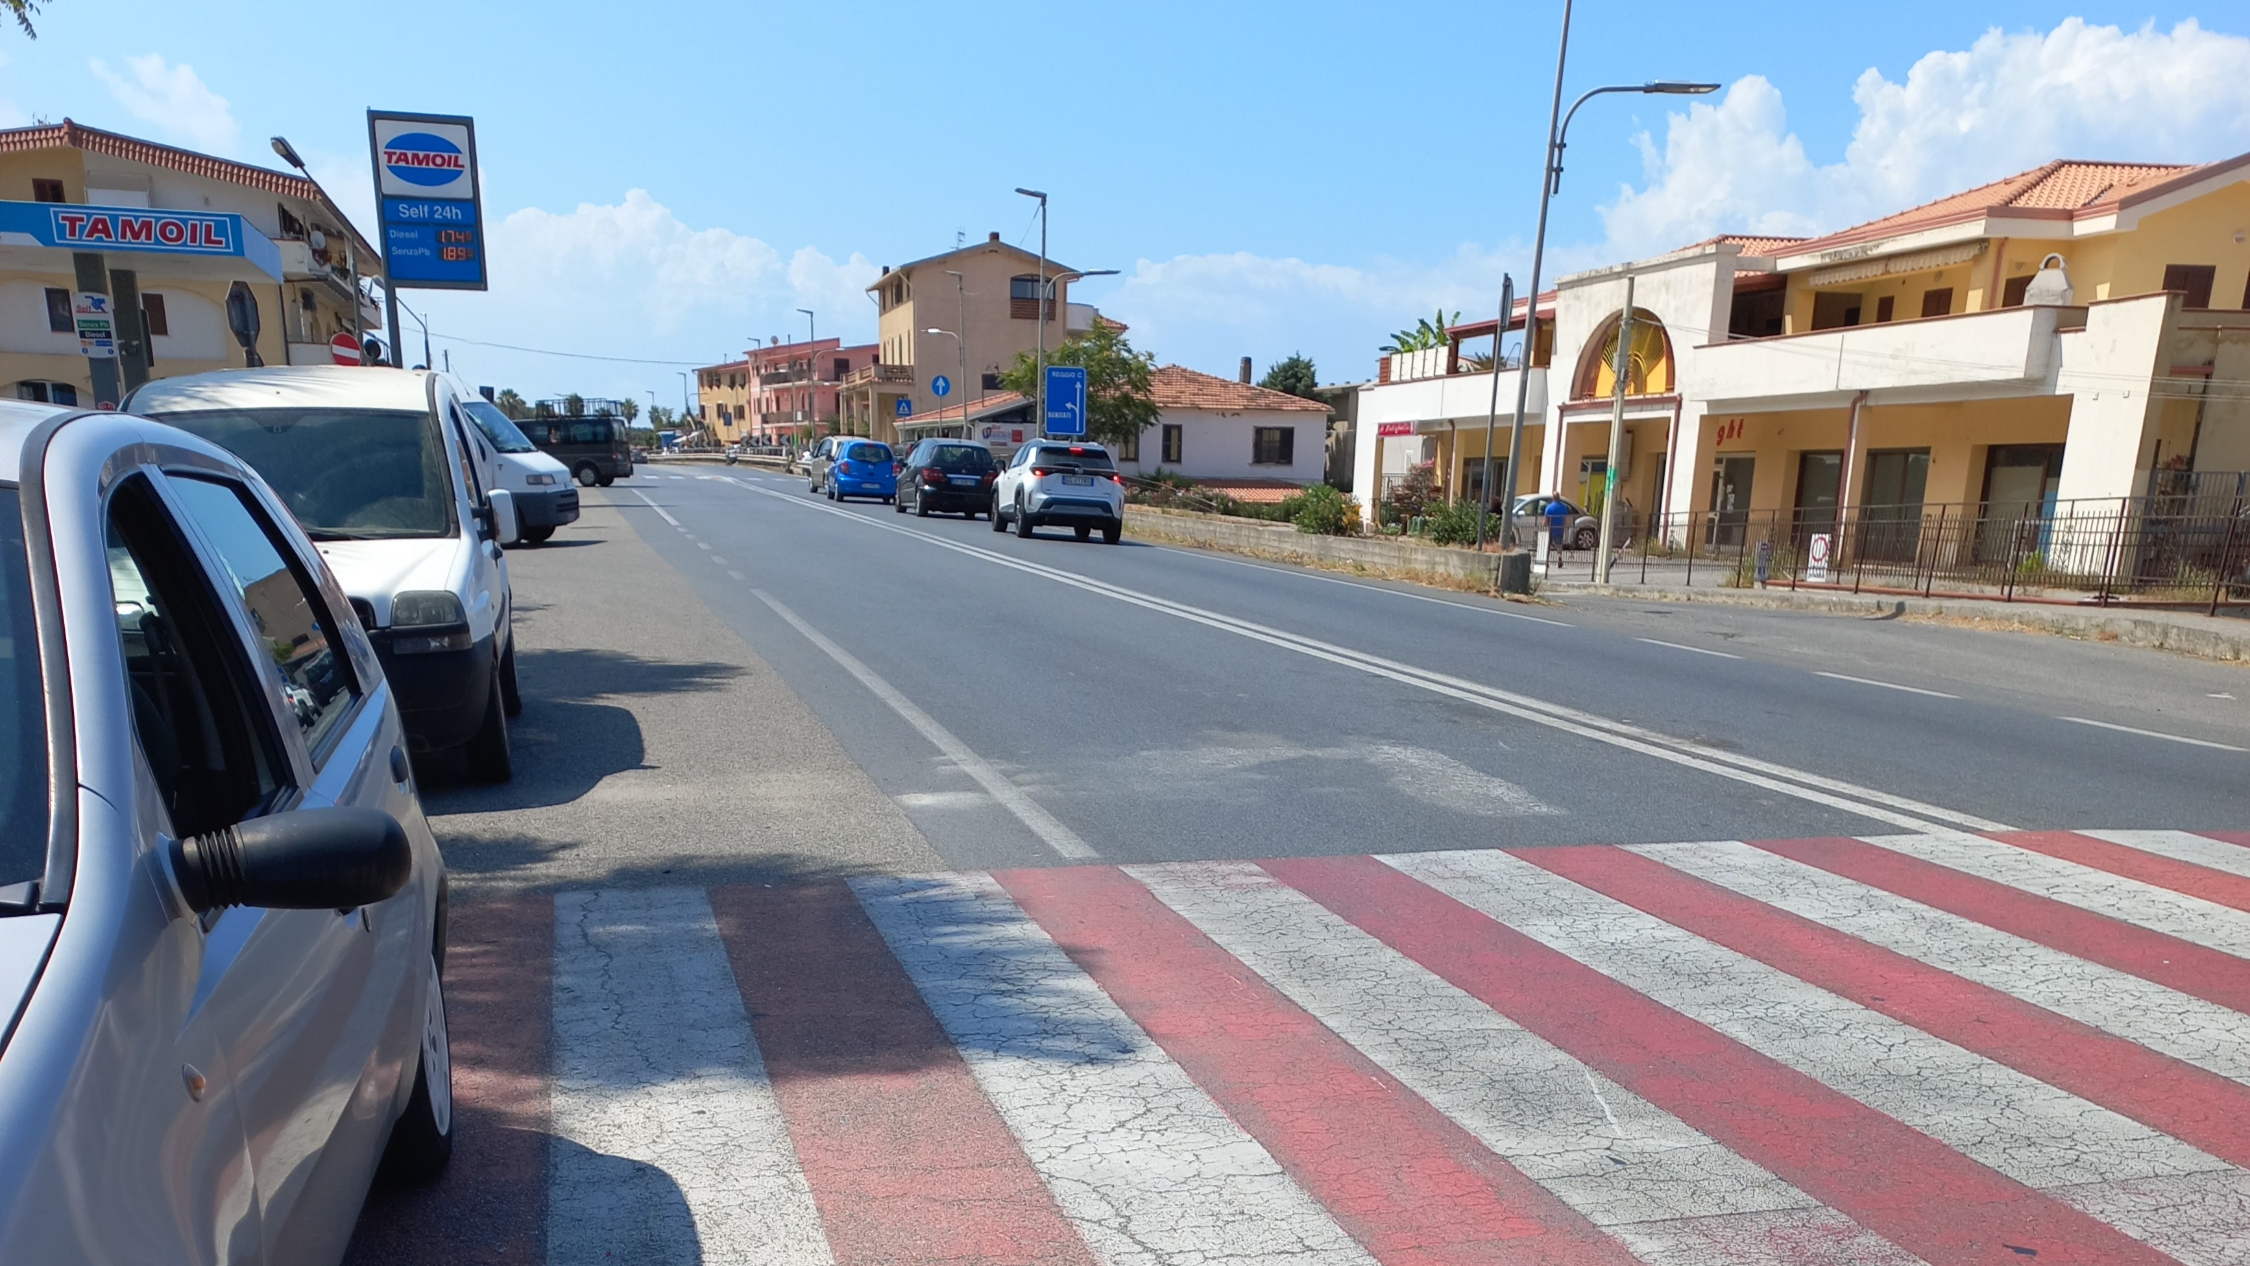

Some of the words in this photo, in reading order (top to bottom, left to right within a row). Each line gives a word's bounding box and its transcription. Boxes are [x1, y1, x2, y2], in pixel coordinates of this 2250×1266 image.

[384, 151, 464, 168] TAMOIL
[398, 204, 429, 218] Self
[433, 205, 462, 220] 24h
[60, 214, 225, 247] TAMOIL
[389, 229, 419, 239] Diesel
